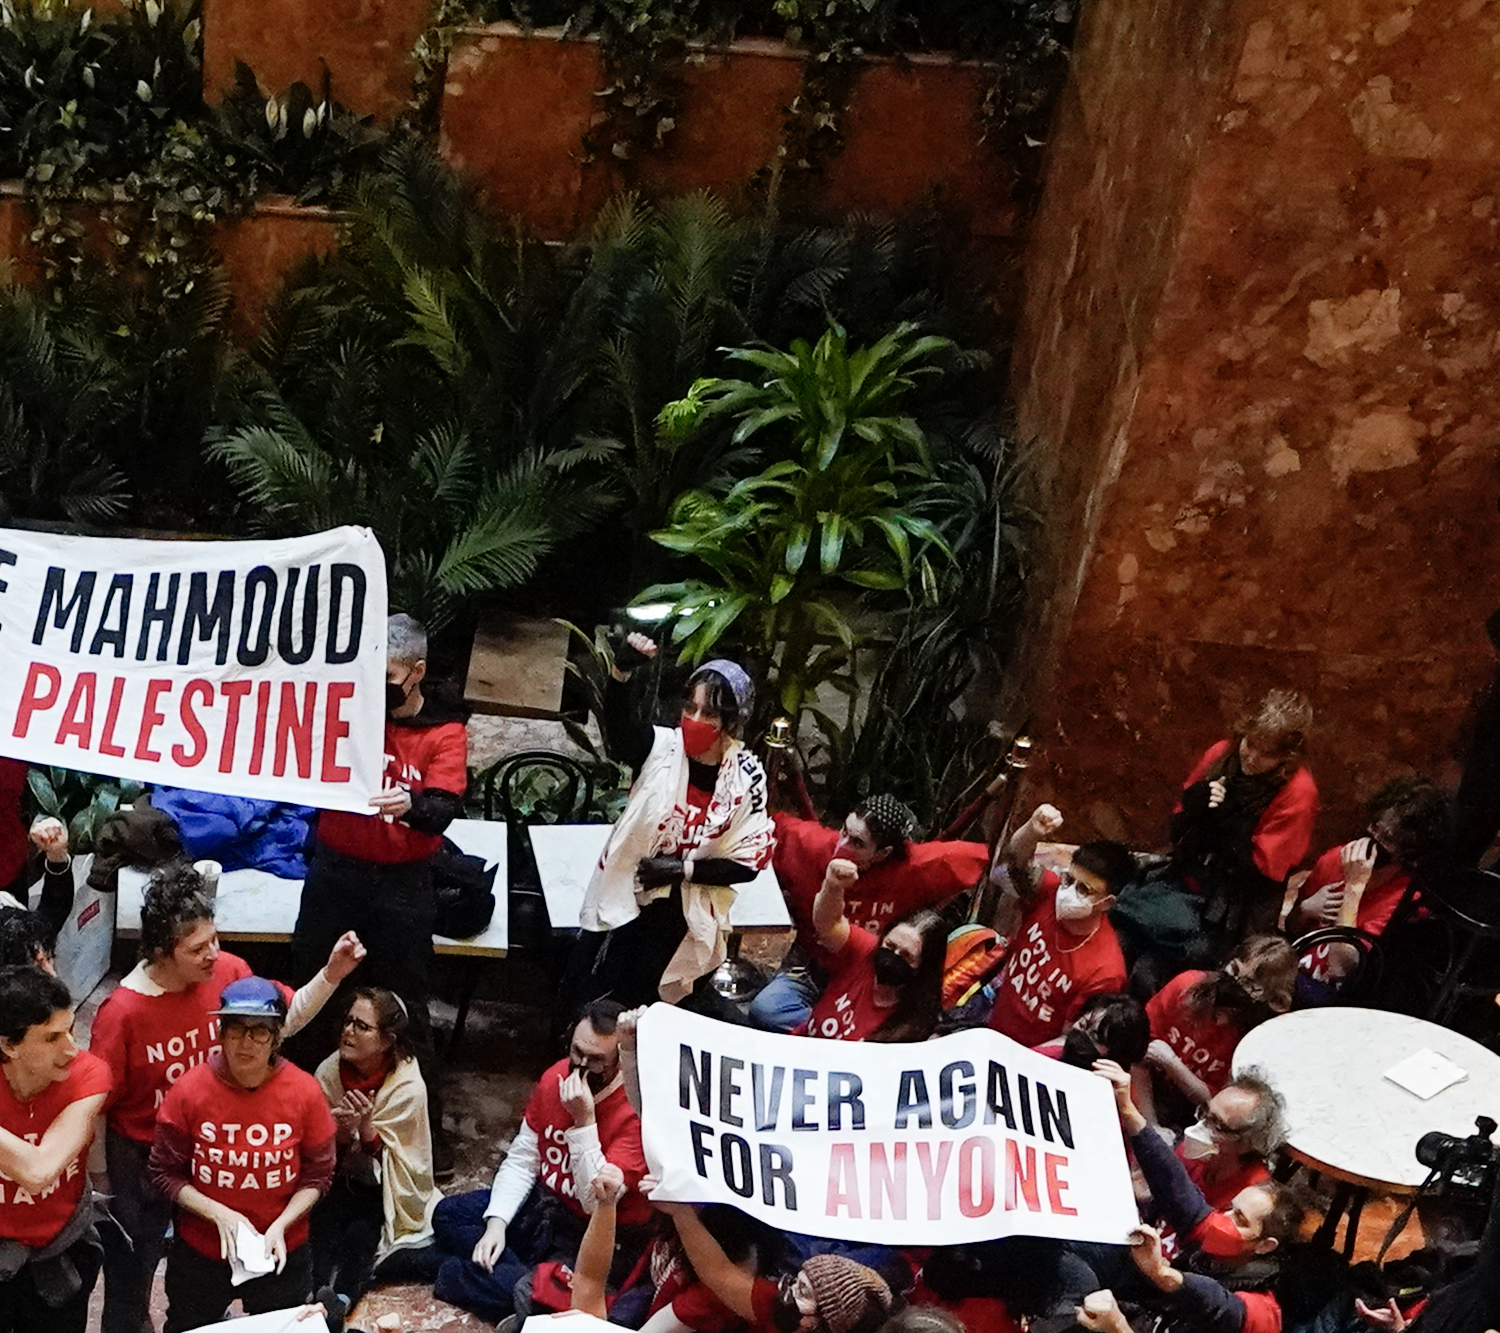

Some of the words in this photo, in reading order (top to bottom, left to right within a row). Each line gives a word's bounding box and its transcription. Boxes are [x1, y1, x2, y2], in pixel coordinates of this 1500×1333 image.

[32, 562, 366, 666] MAHMOUD
[12, 661, 355, 783] PALESTINE
[1027, 921, 1052, 975] NOT
[1048, 967, 1074, 995] IN
[146, 1031, 200, 1064] NOT
[201, 1122, 294, 1148] STOP
[678, 1043, 867, 1132] NEVER
[894, 1060, 1075, 1151] AGAIN
[190, 1164, 297, 1193] ISRAEL
[688, 1121, 798, 1212] FOR
[825, 1134, 1078, 1221] ANYONE
